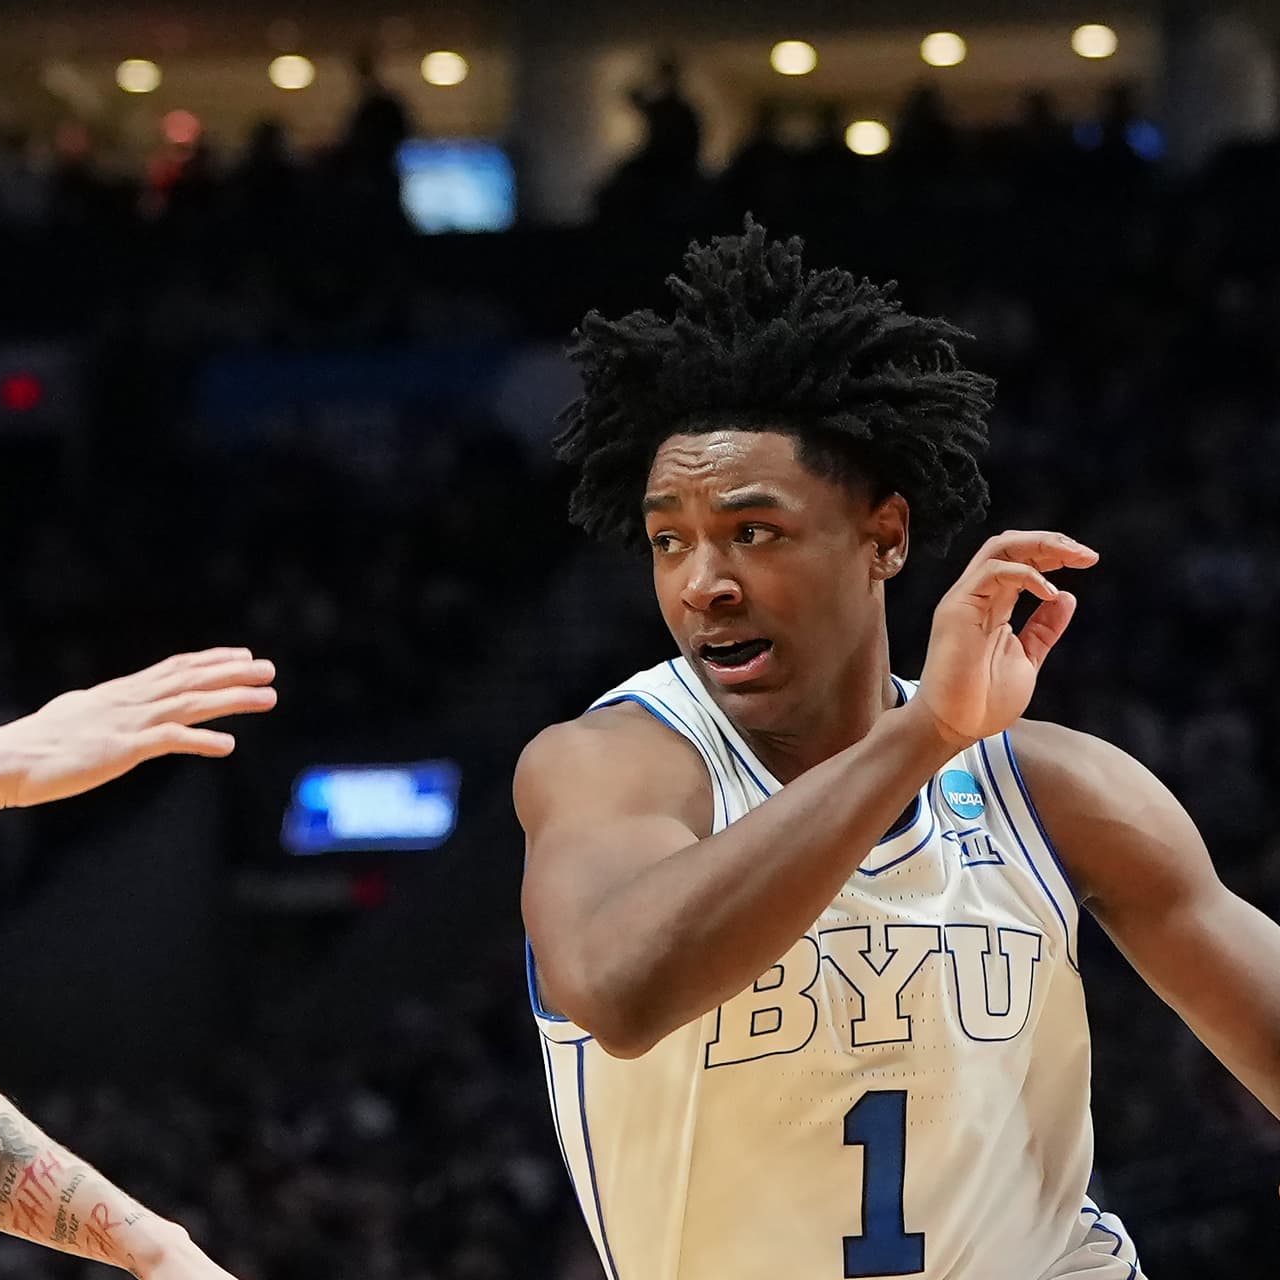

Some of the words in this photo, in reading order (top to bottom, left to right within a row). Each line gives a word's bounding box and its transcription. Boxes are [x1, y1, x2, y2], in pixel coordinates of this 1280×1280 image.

[948, 791, 985, 806] NCAA
[704, 923, 1042, 1070] BYU
[842, 1089, 926, 1280] 1
